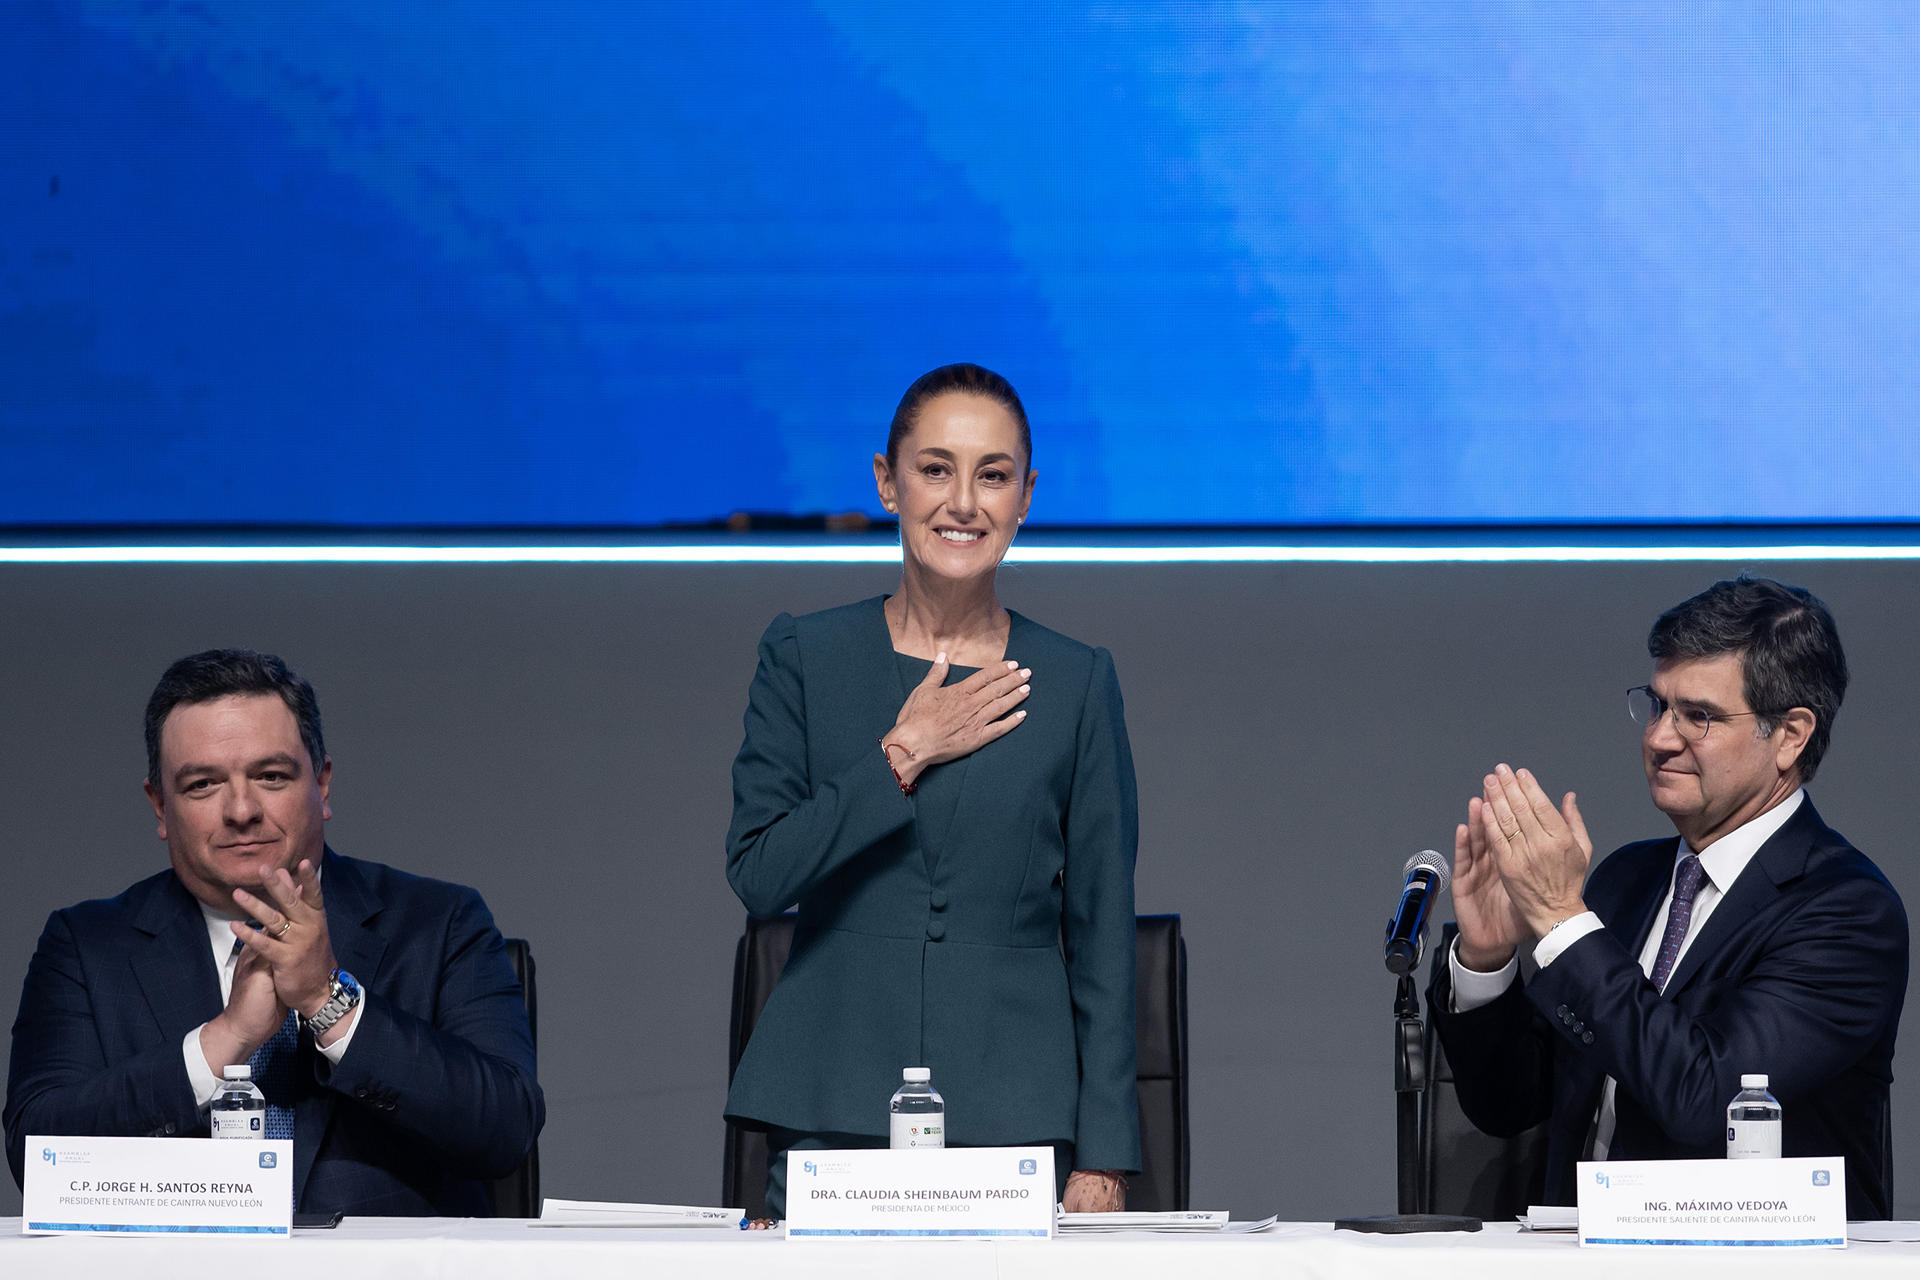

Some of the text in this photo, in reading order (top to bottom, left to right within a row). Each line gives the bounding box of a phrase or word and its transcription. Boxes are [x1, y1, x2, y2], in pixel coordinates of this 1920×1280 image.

[70, 1181, 254, 1195] C.P. JORGE H. SANTOS REYNA
[811, 1189, 1030, 1200] DRA. CLAUDIA SHEINBAUM PARDO
[59, 1196, 263, 1208] PRESIDENTE ENTRANTE DE CAINTRA NUEVO LEÓN
[871, 1202, 970, 1213] PRESIDENTA DE MÉXICO
[1644, 1199, 1788, 1212] ING. MÁXIMO VEDOYA
[1616, 1214, 1816, 1225] PRESIDENTE SALIENTE DE CAINTRA NUEVO LEÓN
